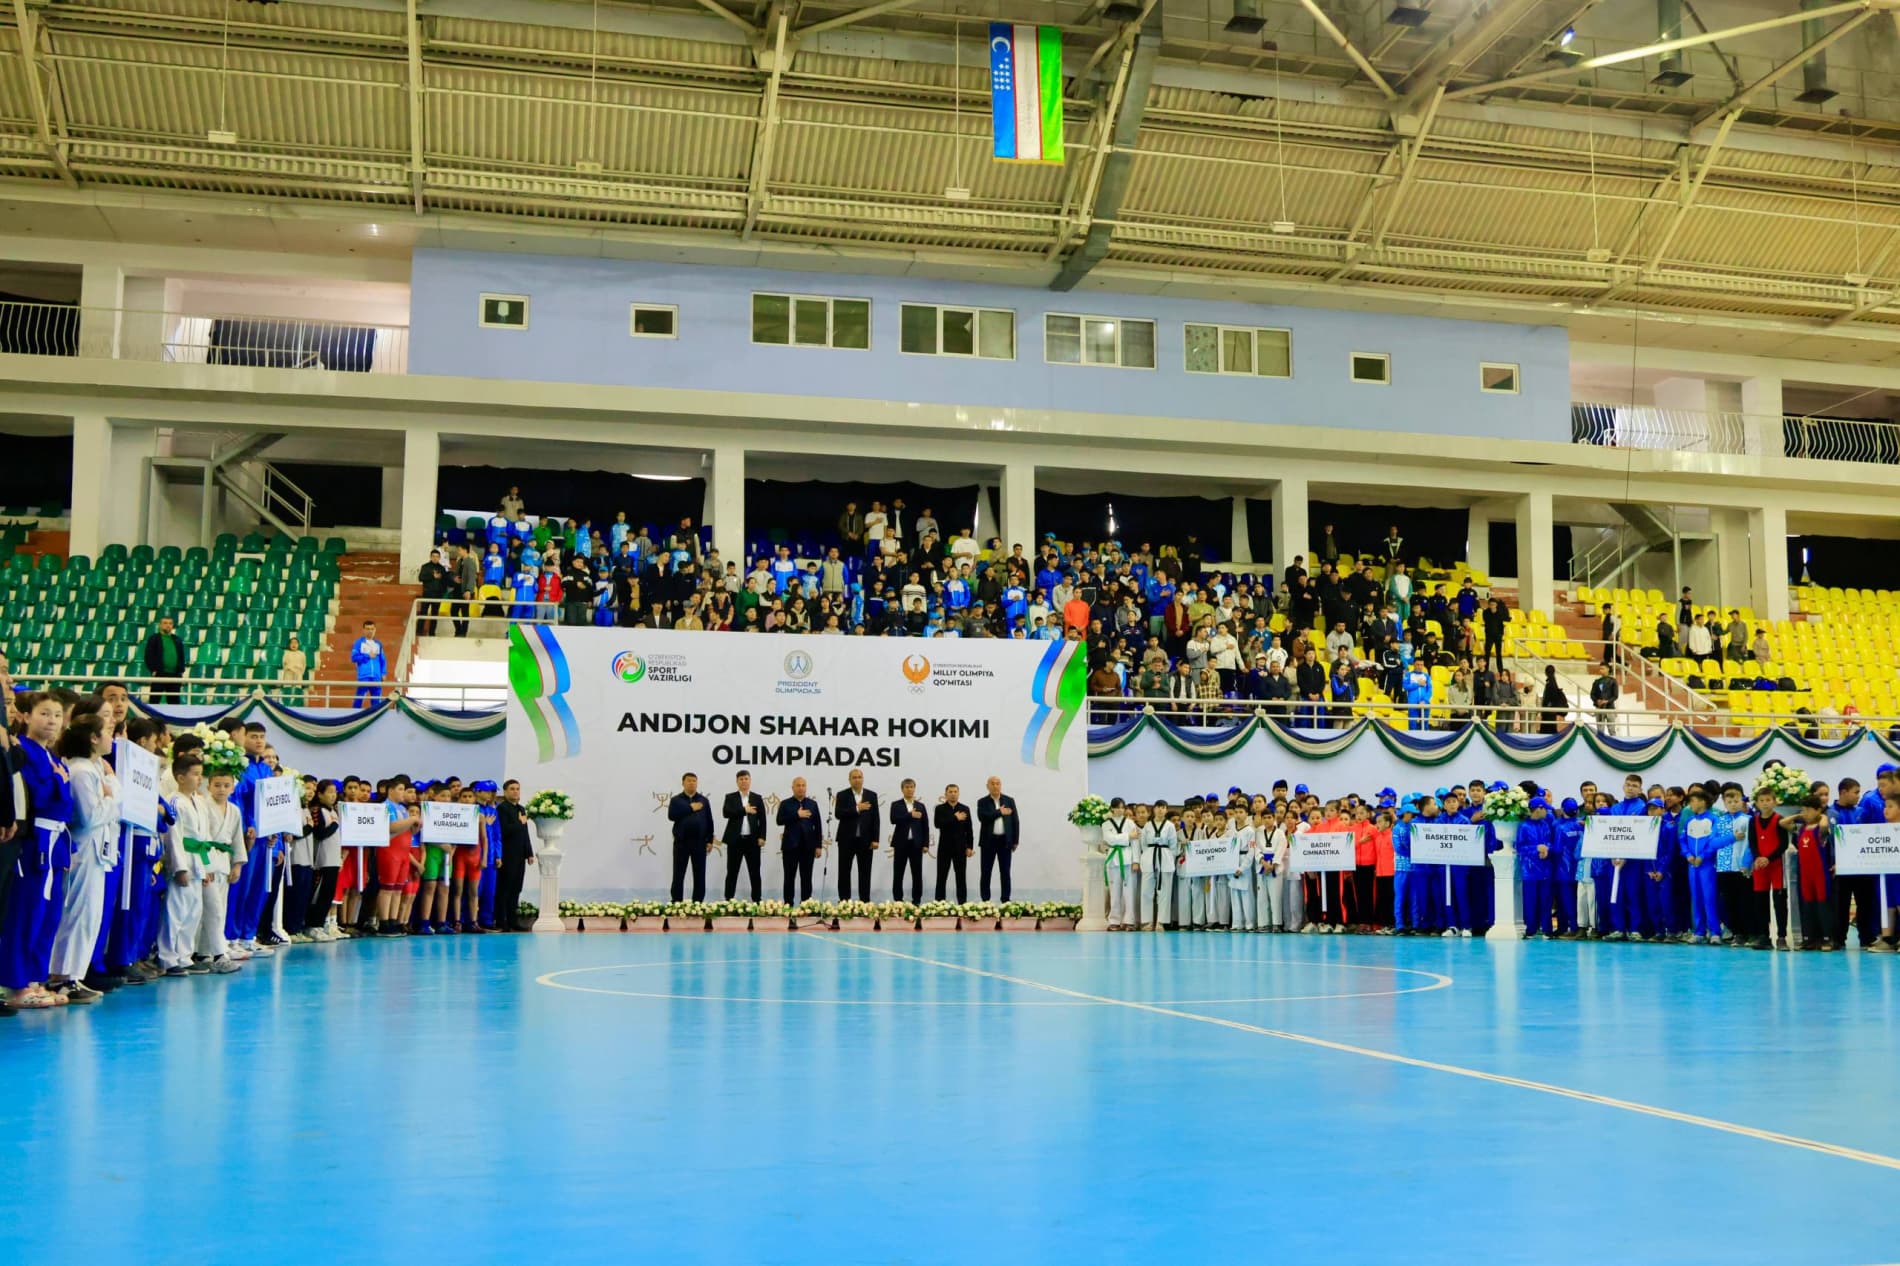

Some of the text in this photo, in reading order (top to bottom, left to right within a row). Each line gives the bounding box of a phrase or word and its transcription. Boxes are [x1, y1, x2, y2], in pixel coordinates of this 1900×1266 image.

[648, 674, 692, 682] VAZIRLIGI
[617, 712, 989, 738] ANDIJON SHAHAR HOKIMI
[712, 745, 900, 767] OLIMPIADASI
[266, 793, 291, 807] VOLEYBOL
[357, 817, 375, 825] BOKS
[1425, 833, 1468, 841] BASKETBOL
[1868, 836, 1891, 844] OG'IR
[1195, 847, 1226, 855] TAEKVONDO
[1860, 846, 1899, 854] ATLETIKA
